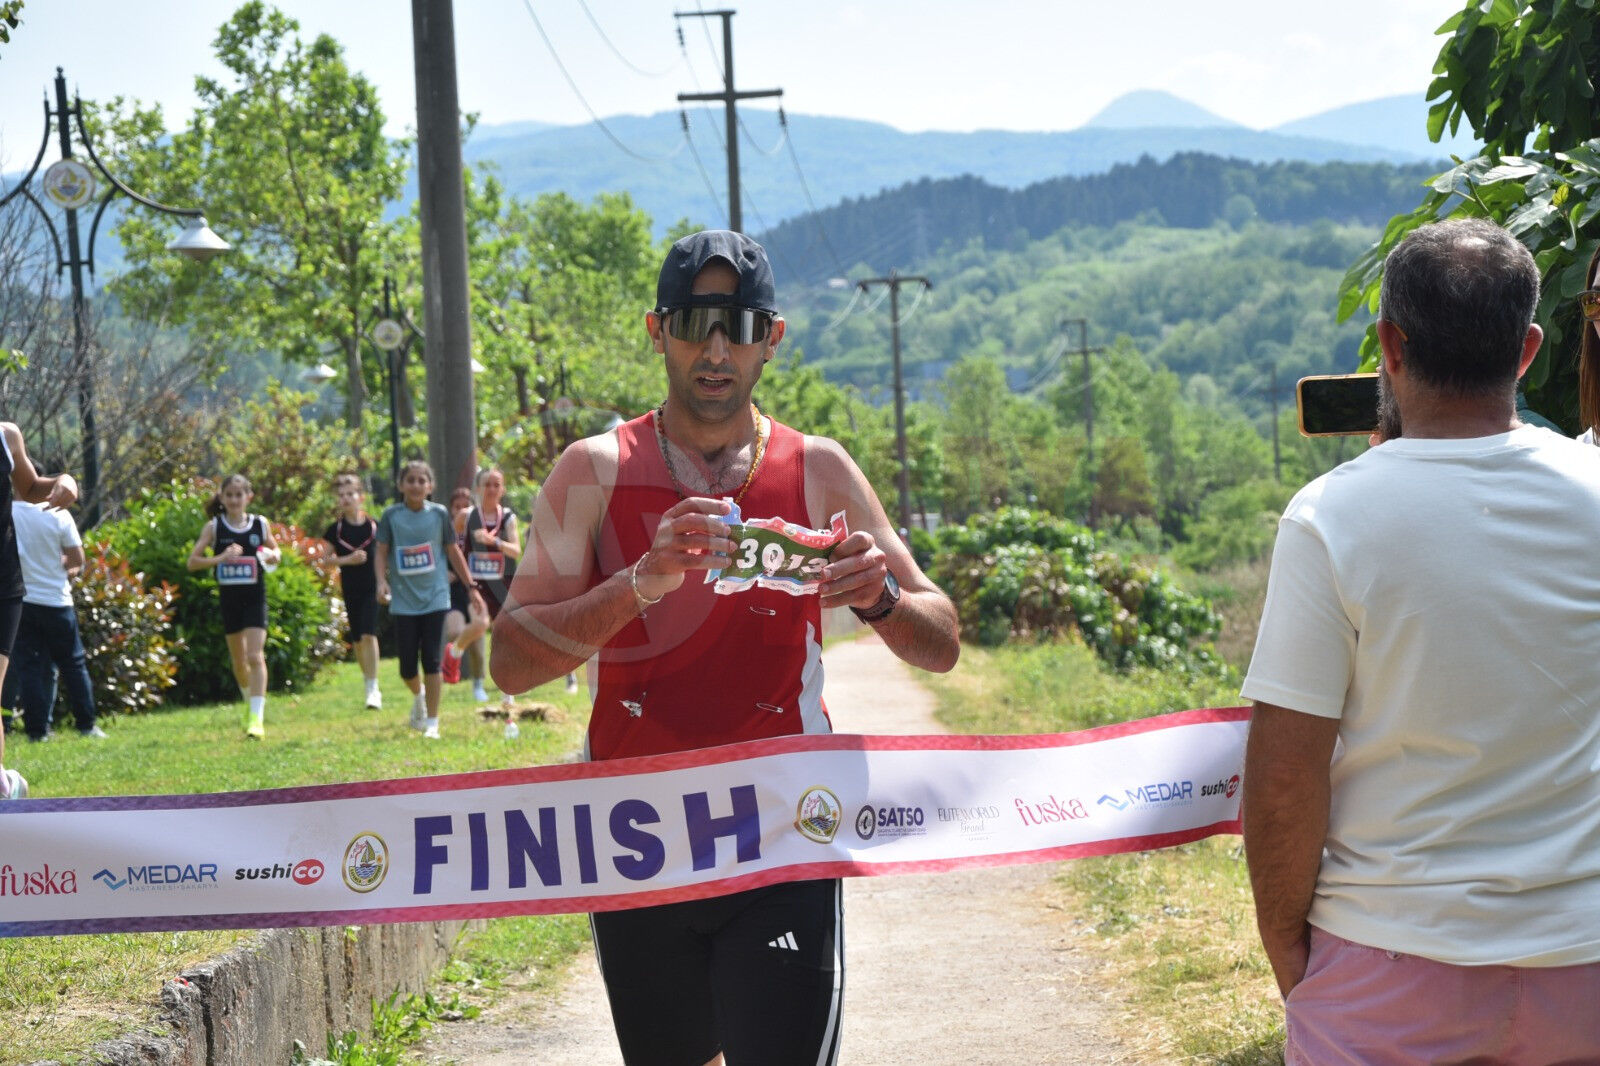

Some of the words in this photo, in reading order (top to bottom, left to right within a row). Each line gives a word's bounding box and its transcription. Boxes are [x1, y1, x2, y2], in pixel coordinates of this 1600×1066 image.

[1125, 780, 1193, 805] MEDAR
[877, 807, 924, 826] SATSO
[1014, 795, 1090, 826] fuska
[413, 784, 762, 894] FINISH
[0, 863, 78, 897] fuska
[127, 863, 218, 885] MEDAR
[234, 862, 324, 881] sushico
